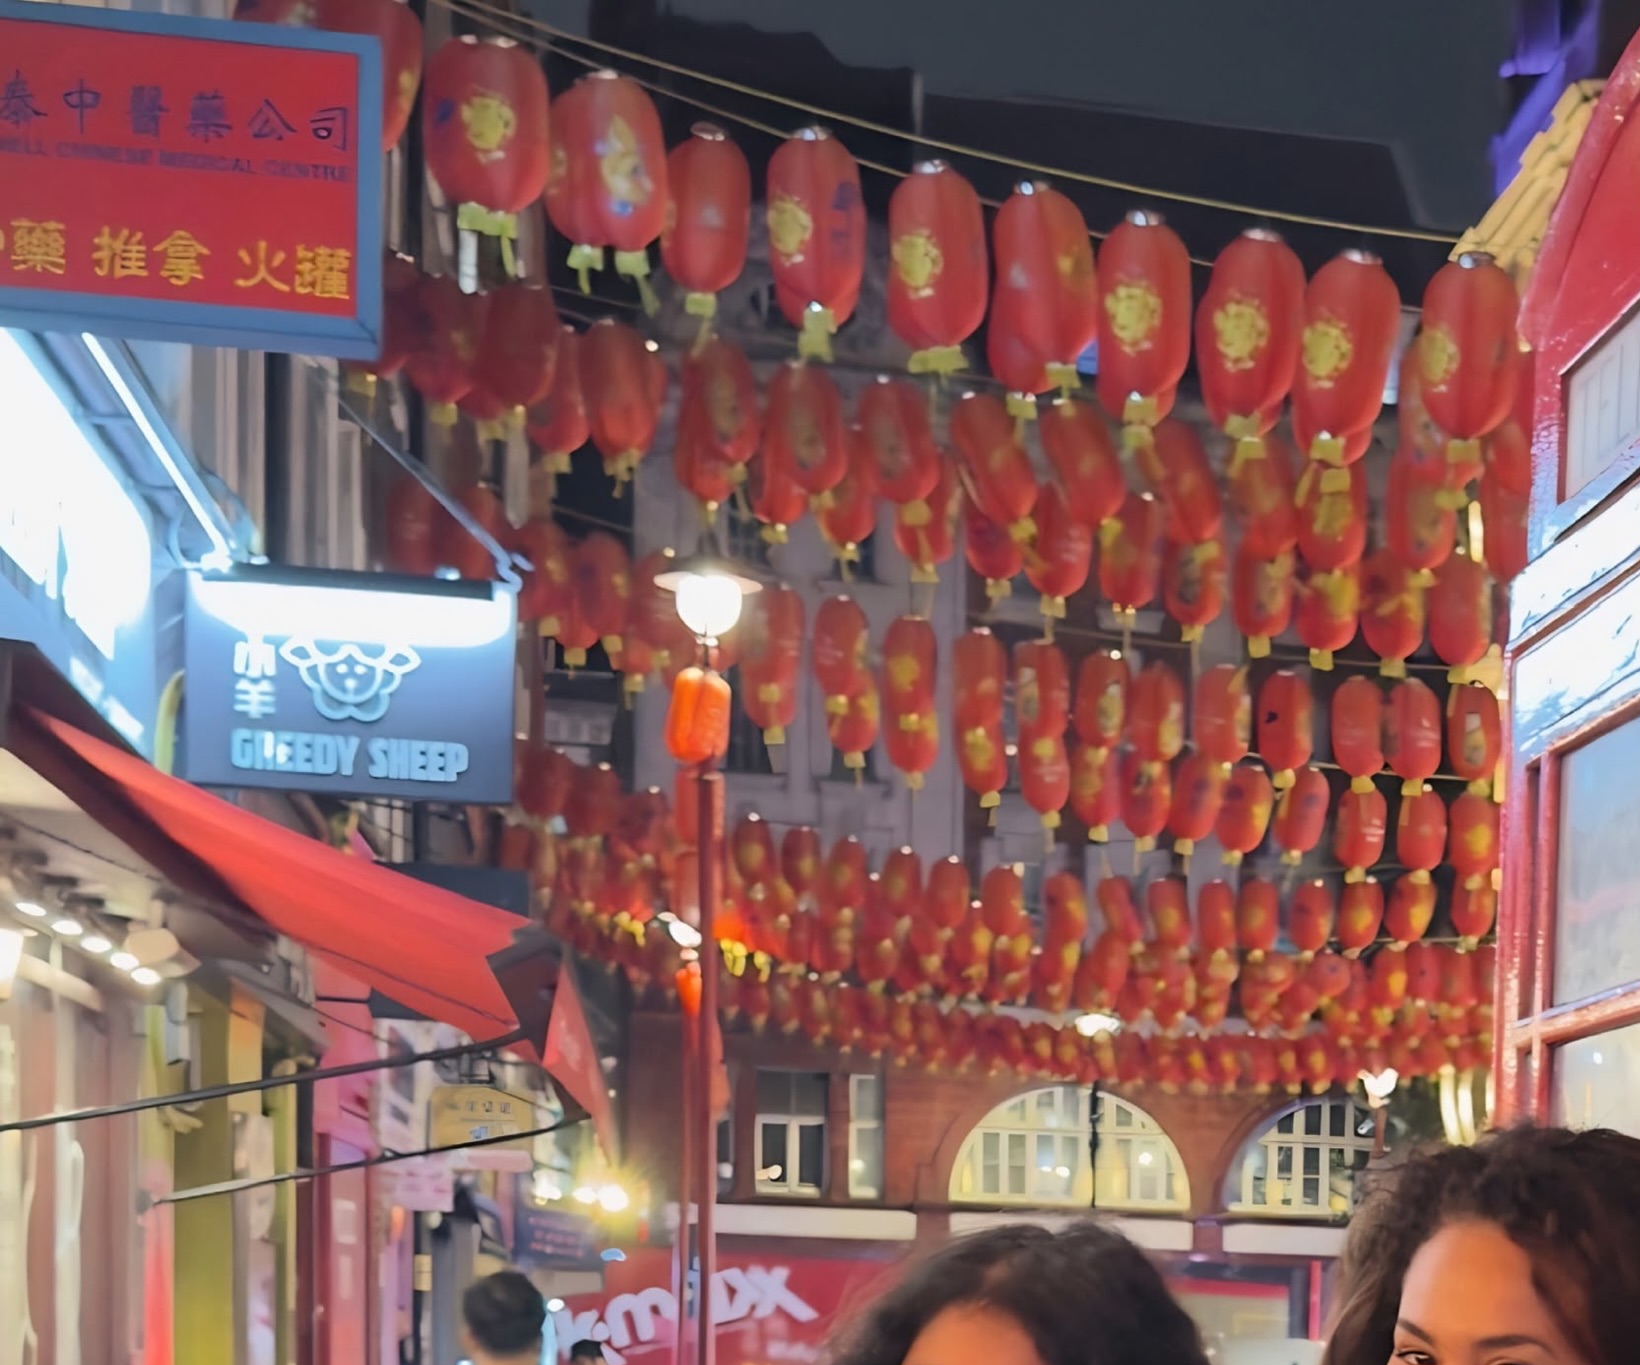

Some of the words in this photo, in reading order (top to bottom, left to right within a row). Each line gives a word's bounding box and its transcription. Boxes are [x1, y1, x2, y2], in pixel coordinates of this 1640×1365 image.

[159, 151, 256, 174] MEDICAL
[231, 728, 360, 777] GREEDY
[368, 736, 469, 783] SHEEP
